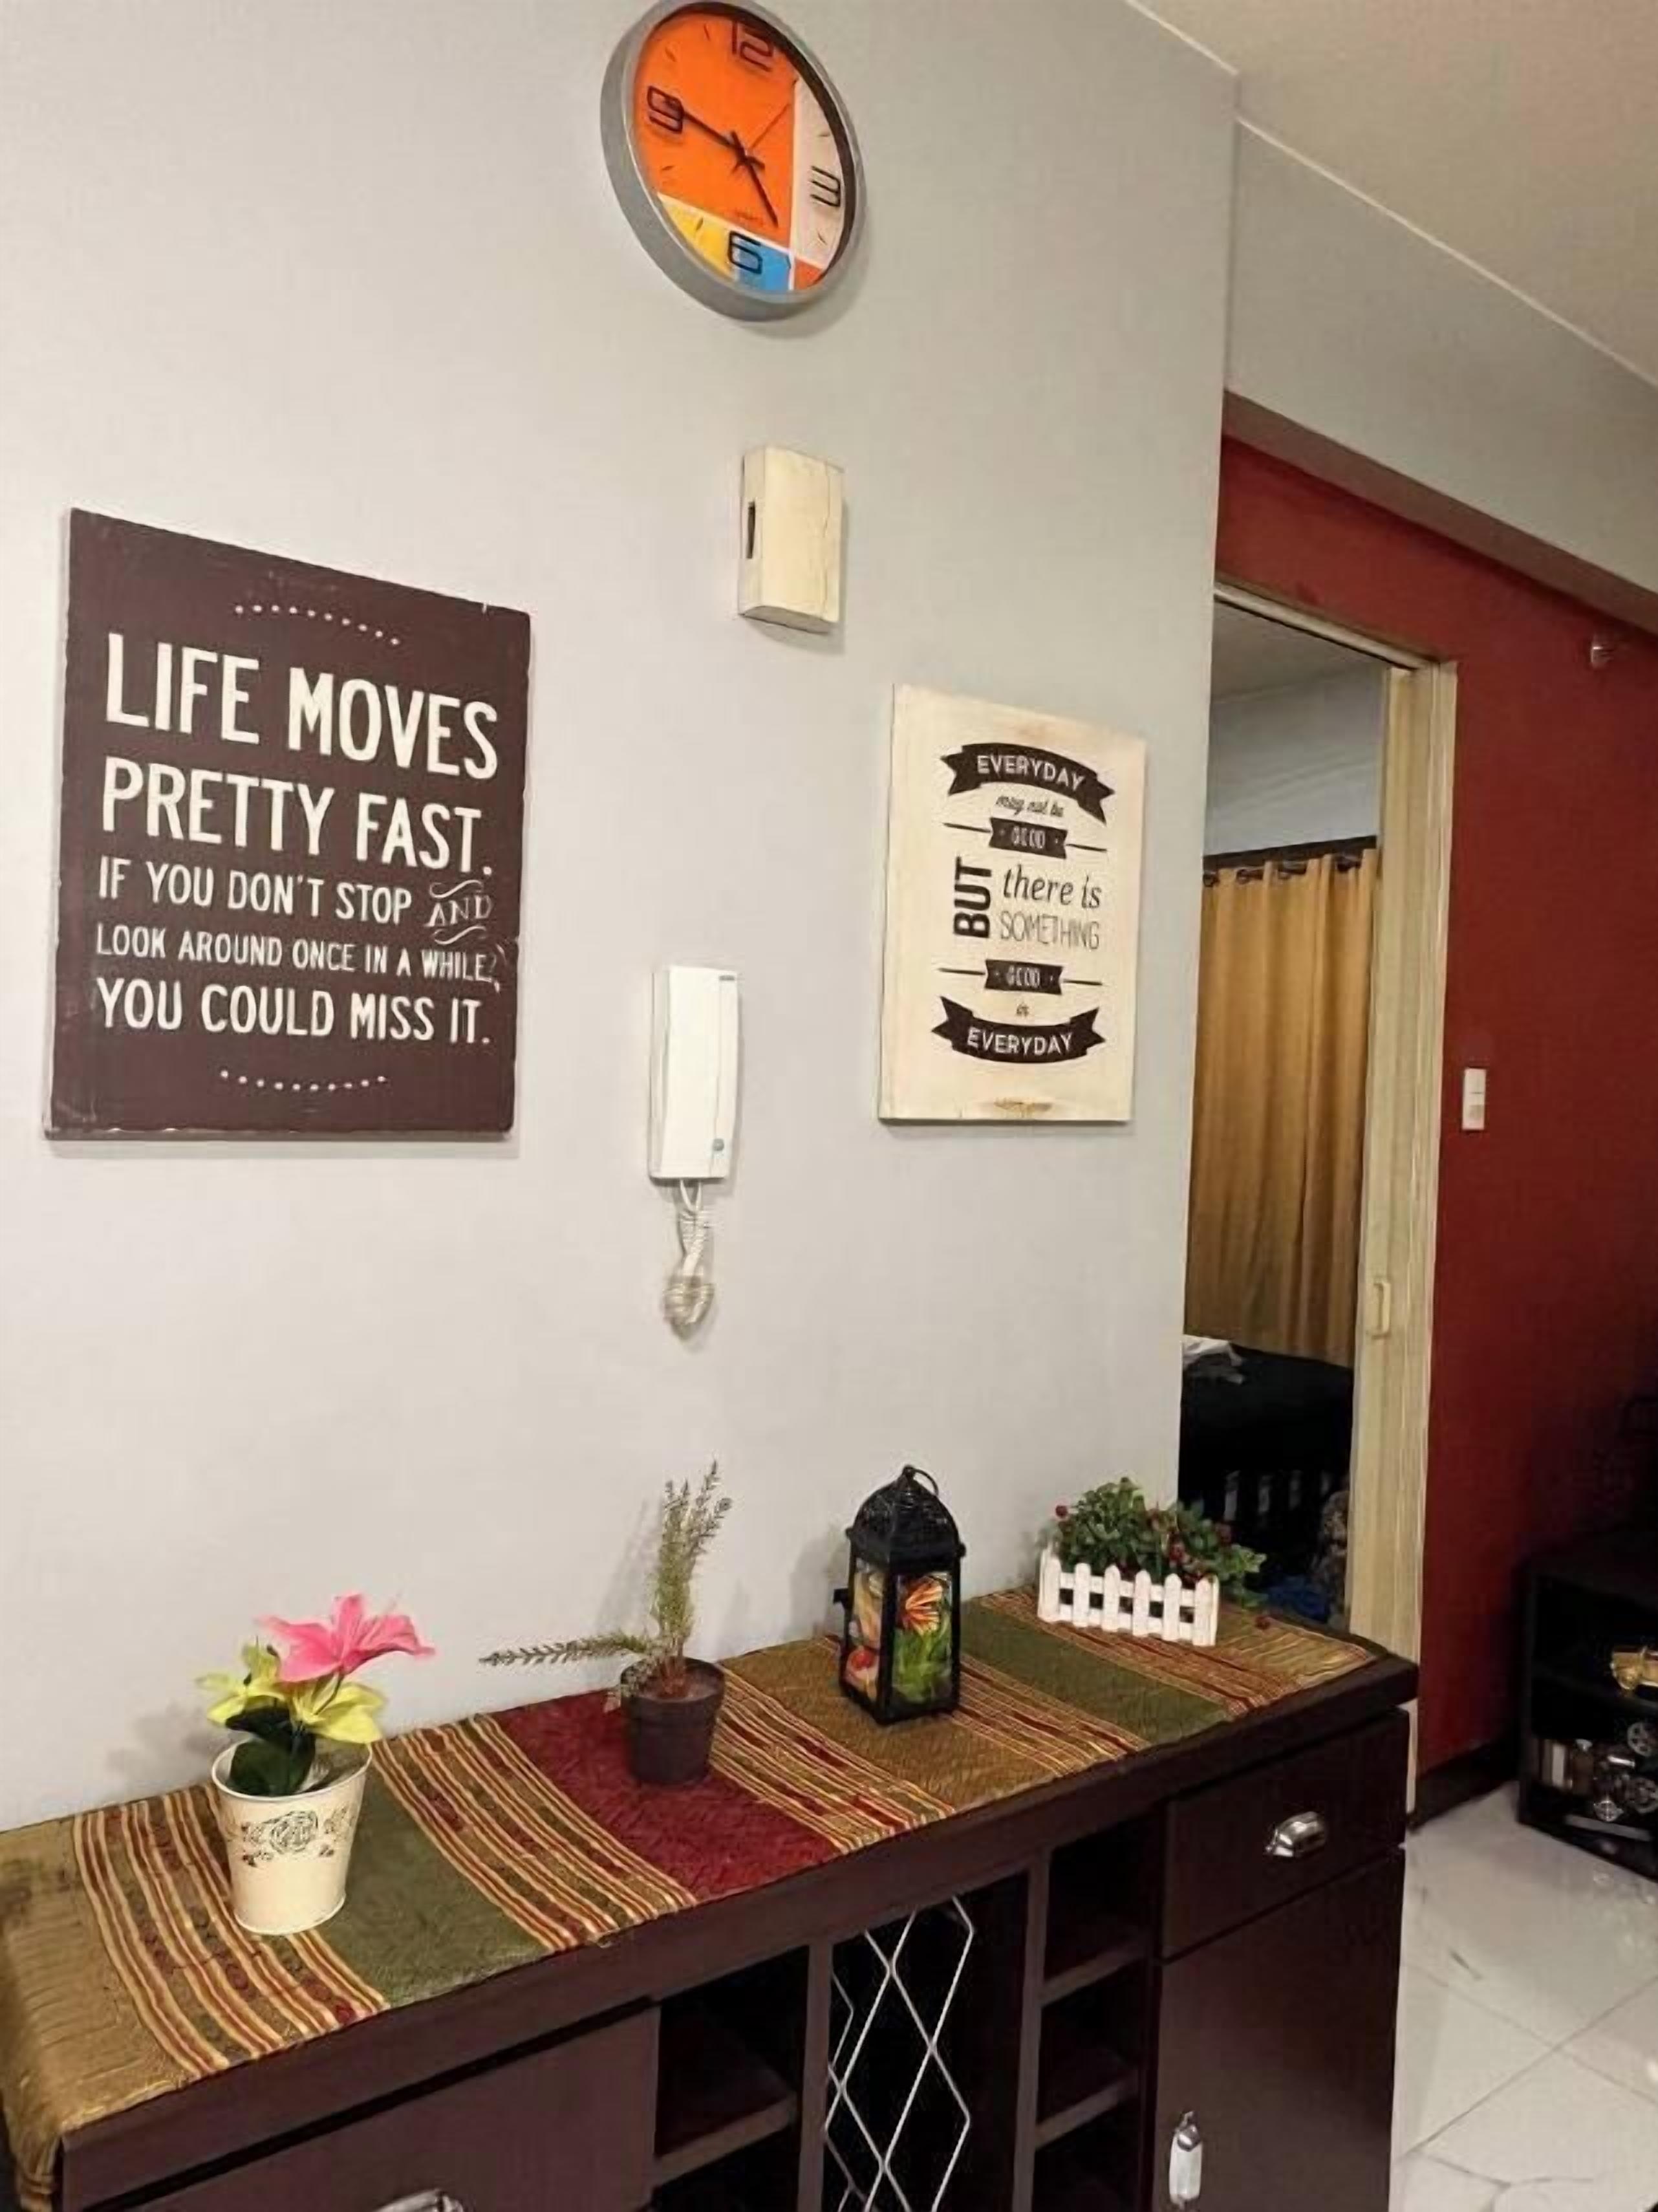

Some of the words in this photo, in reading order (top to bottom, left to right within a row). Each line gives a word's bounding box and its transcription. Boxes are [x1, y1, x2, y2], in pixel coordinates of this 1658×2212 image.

[731, 19, 774, 72] 12
[647, 85, 684, 135] 9
[811, 166, 841, 208] 3
[728, 230, 764, 274] 6
[105, 632, 260, 744] LIFE
[288, 666, 499, 780] MOVES
[977, 754, 1084, 790] EVERYDAY
[102, 755, 335, 856] PRETTY
[356, 792, 493, 876] FAST.
[98, 856, 131, 900] IF
[145, 861, 214, 907] YOU
[228, 870, 325, 916] DON'T
[336, 882, 412, 924] STOP
[424, 895, 493, 927] AND
[954, 856, 992, 938] BUT
[1003, 863, 1073, 905] there
[1081, 874, 1102, 909] is
[96, 922, 167, 960] LOOK
[178, 929, 283, 966] AROUND
[292, 938, 355, 972] ONCE
[365, 944, 388, 974] IN
[396, 947, 412, 977] A
[1000, 910, 1101, 949] SOMETHING
[96, 976, 183, 1030] YOU
[200, 983, 334, 1036] COULD
[350, 992, 435, 1041] MISS
[450, 997, 490, 1045] IT.
[967, 1026, 1073, 1056] EVERYDAY
